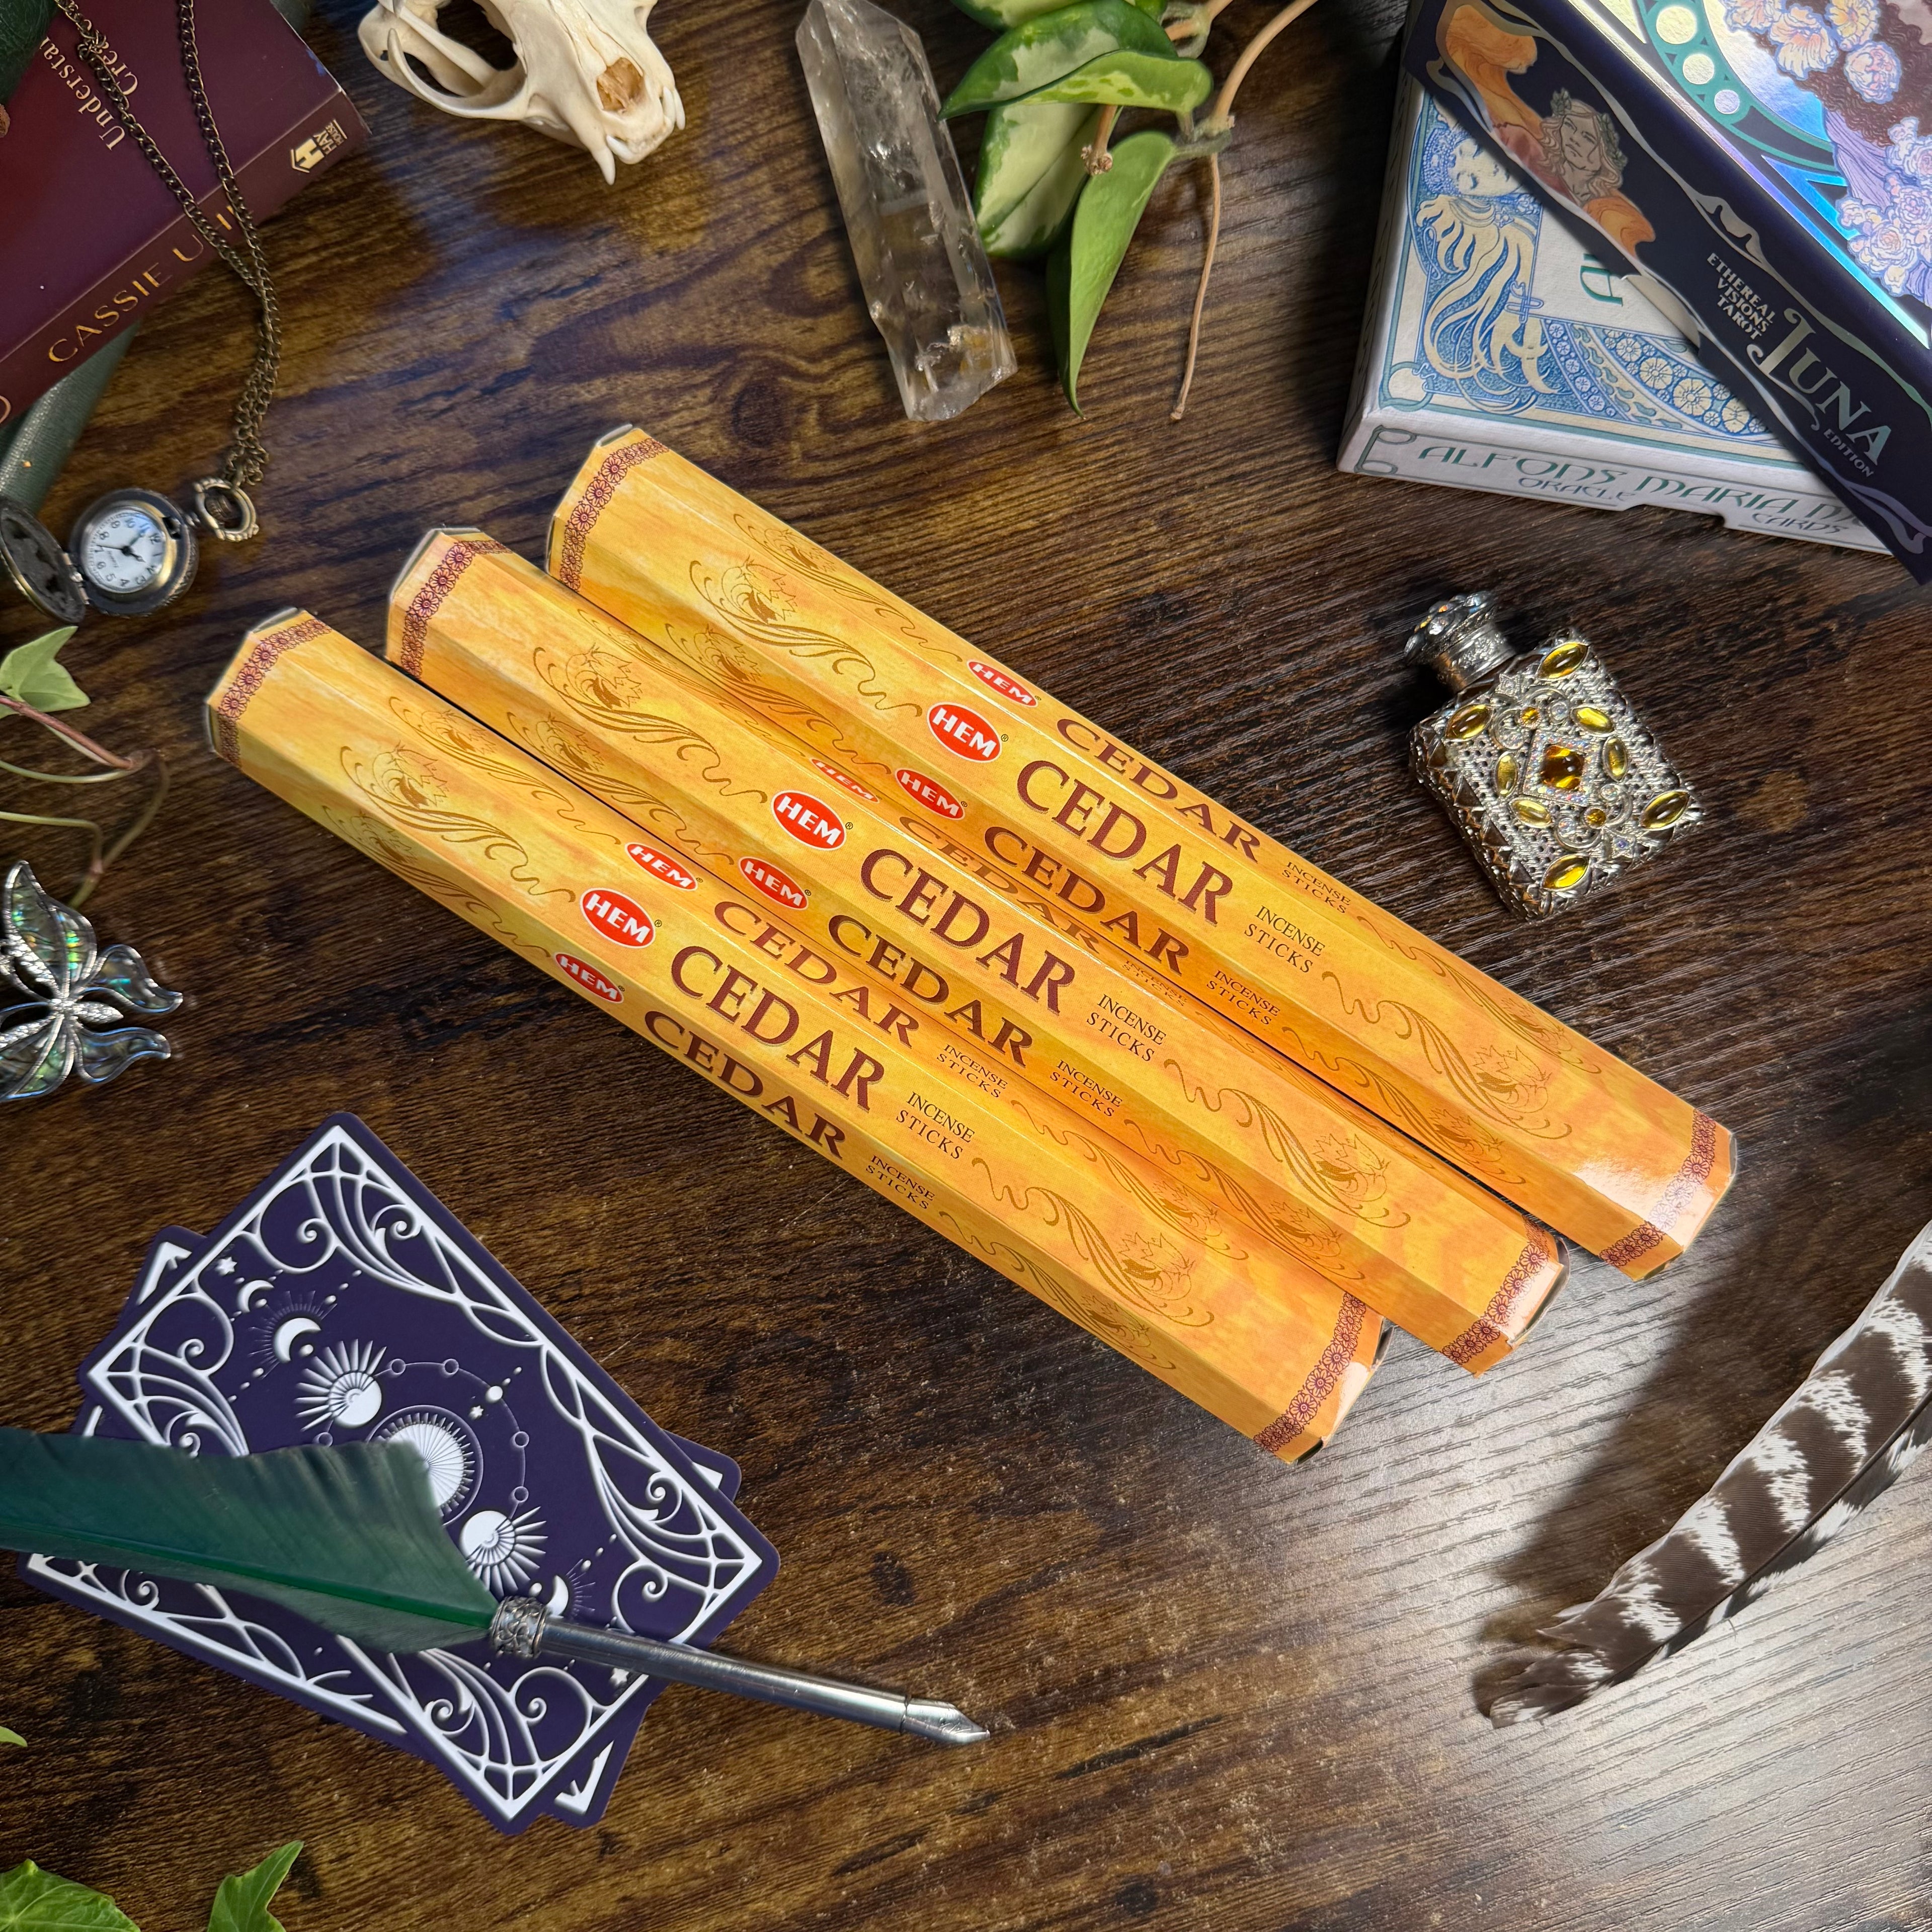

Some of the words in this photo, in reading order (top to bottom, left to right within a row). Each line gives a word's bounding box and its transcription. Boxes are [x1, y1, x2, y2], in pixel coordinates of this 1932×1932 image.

[313, 130, 337, 154] HAY
[48, 263, 172, 362] CASSIE
[1707, 253, 1776, 324] ETHEREAL
[1717, 278, 1769, 332] VISIONS
[1717, 296, 1762, 340] TAROT
[1746, 308, 1891, 465] LUNA
[1823, 429, 1874, 477] EDITION
[1518, 478, 1636, 501] ORACLE
[1752, 513, 1849, 534] CARDS
[1634, 476, 1798, 514] MARIA
[973, 664, 1032, 704] HEM
[932, 707, 998, 758] HEM
[816, 762, 874, 799] HEM
[900, 771, 959, 818] HEM
[1057, 718, 1261, 864] CEDAR
[777, 795, 842, 846] HEM
[1016, 760, 1233, 926] CEDAR
[631, 846, 693, 889] HEM
[744, 860, 803, 907] HEM
[900, 817, 1099, 954] CEDAR
[1282, 869, 1346, 913] STICKS
[1287, 862, 1351, 905] INCENSE
[585, 894, 651, 944] HEM
[985, 827, 1189, 976] CEDAR
[860, 849, 1075, 1016] CEDAR
[1244, 923, 1313, 974] STICKS
[1255, 906, 1326, 956] INCENSE
[559, 956, 619, 1001] HEM
[714, 901, 919, 1049] CEDAR
[829, 915, 1032, 1068] CEDAR
[1215, 970, 1280, 1017] INCENSE
[1097, 994, 1166, 1045] INCENSE
[1206, 980, 1272, 1025] STICKS
[671, 946, 884, 1112] CEDAR
[1087, 1013, 1156, 1062] STICKS
[645, 1011, 846, 1159] CEDAR
[936, 1054, 1001, 1098] STICKS
[943, 1044, 1008, 1089] INCENSE
[1057, 1061, 1123, 1107] INCENSE
[906, 1092, 975, 1143] INCENSE
[1050, 1072, 1115, 1117] STICKS
[896, 1110, 963, 1159] STICKS
[865, 1165, 929, 1209] STICKS
[871, 1156, 935, 1201] INCENSE
